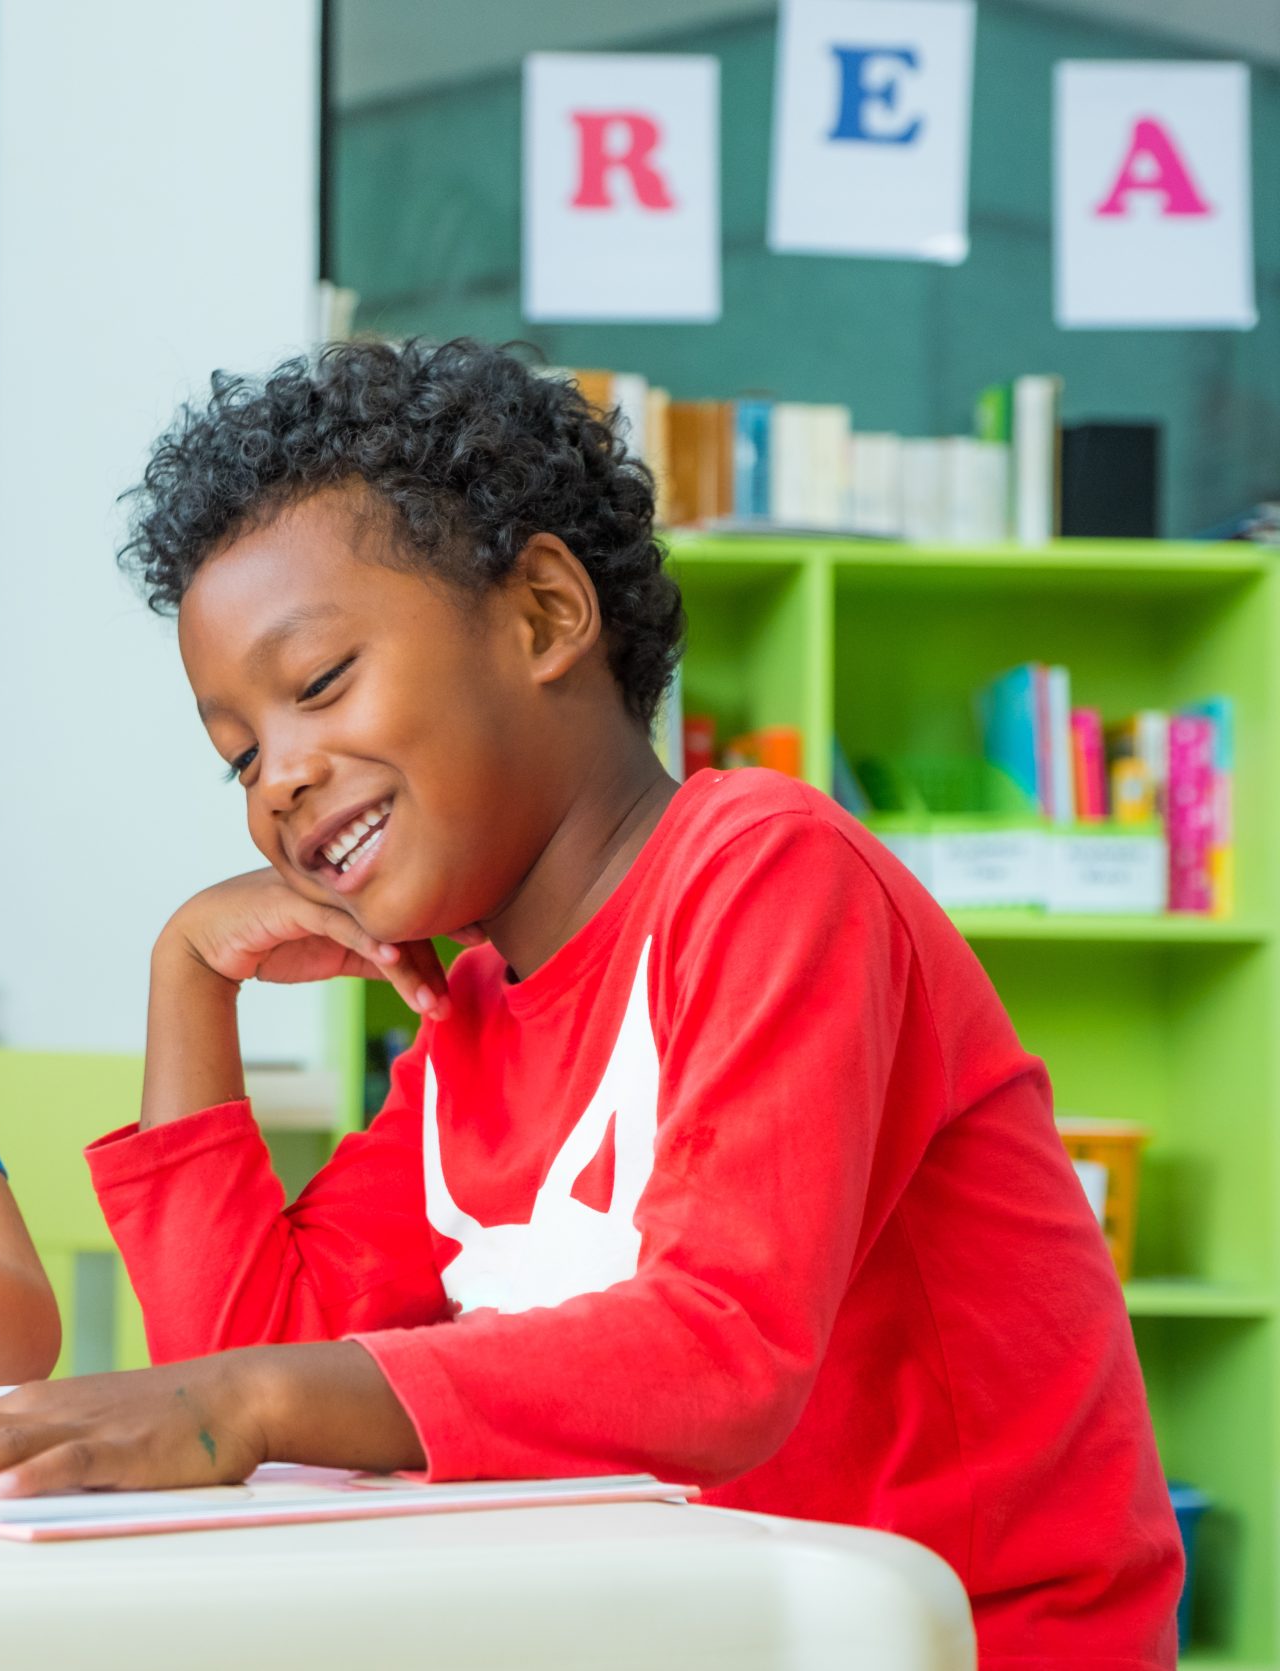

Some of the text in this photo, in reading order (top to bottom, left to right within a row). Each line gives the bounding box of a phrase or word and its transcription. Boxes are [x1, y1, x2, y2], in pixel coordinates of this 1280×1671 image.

[570, 45, 1210, 218] R E A
